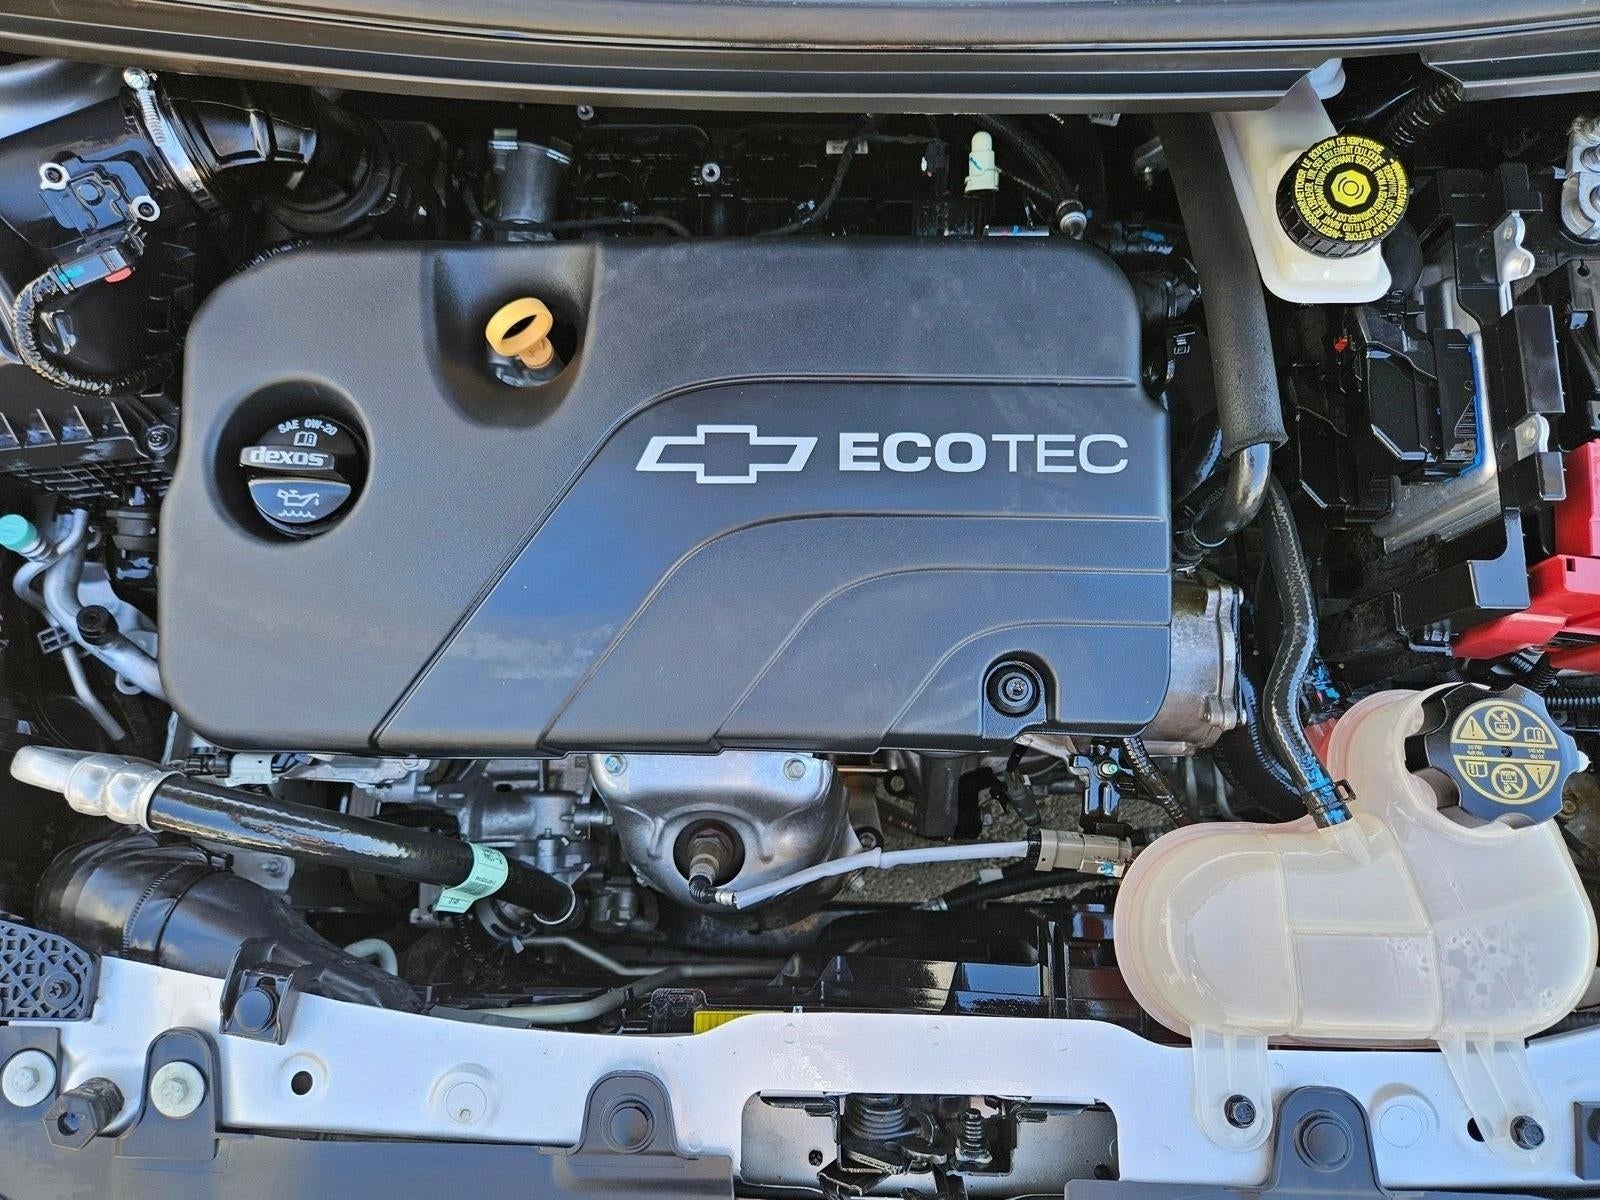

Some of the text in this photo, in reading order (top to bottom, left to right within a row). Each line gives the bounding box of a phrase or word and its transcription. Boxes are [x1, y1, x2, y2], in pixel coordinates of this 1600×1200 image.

[1301, 158, 1314, 169] LE
[1308, 140, 1336, 161] BOUCHON
[1336, 137, 1346, 147] DE
[1347, 137, 1384, 155] REMPLISSAGE
[1313, 208, 1324, 218] DE
[1354, 146, 1364, 155] DU
[1374, 169, 1387, 185] FROM
[1373, 191, 1387, 210] SEALED
[1383, 199, 1395, 212] USE
[1374, 210, 1388, 224] ONLY
[1384, 206, 1403, 226] FILLER
[1343, 223, 1360, 231] FLUID
[1345, 230, 1372, 241] BEFORE
[1373, 223, 1387, 236] CAP
[278, 418, 338, 436] SAE 0W-20
[250, 446, 328, 466] dexos
[839, 431, 1129, 474] ECOTEC
